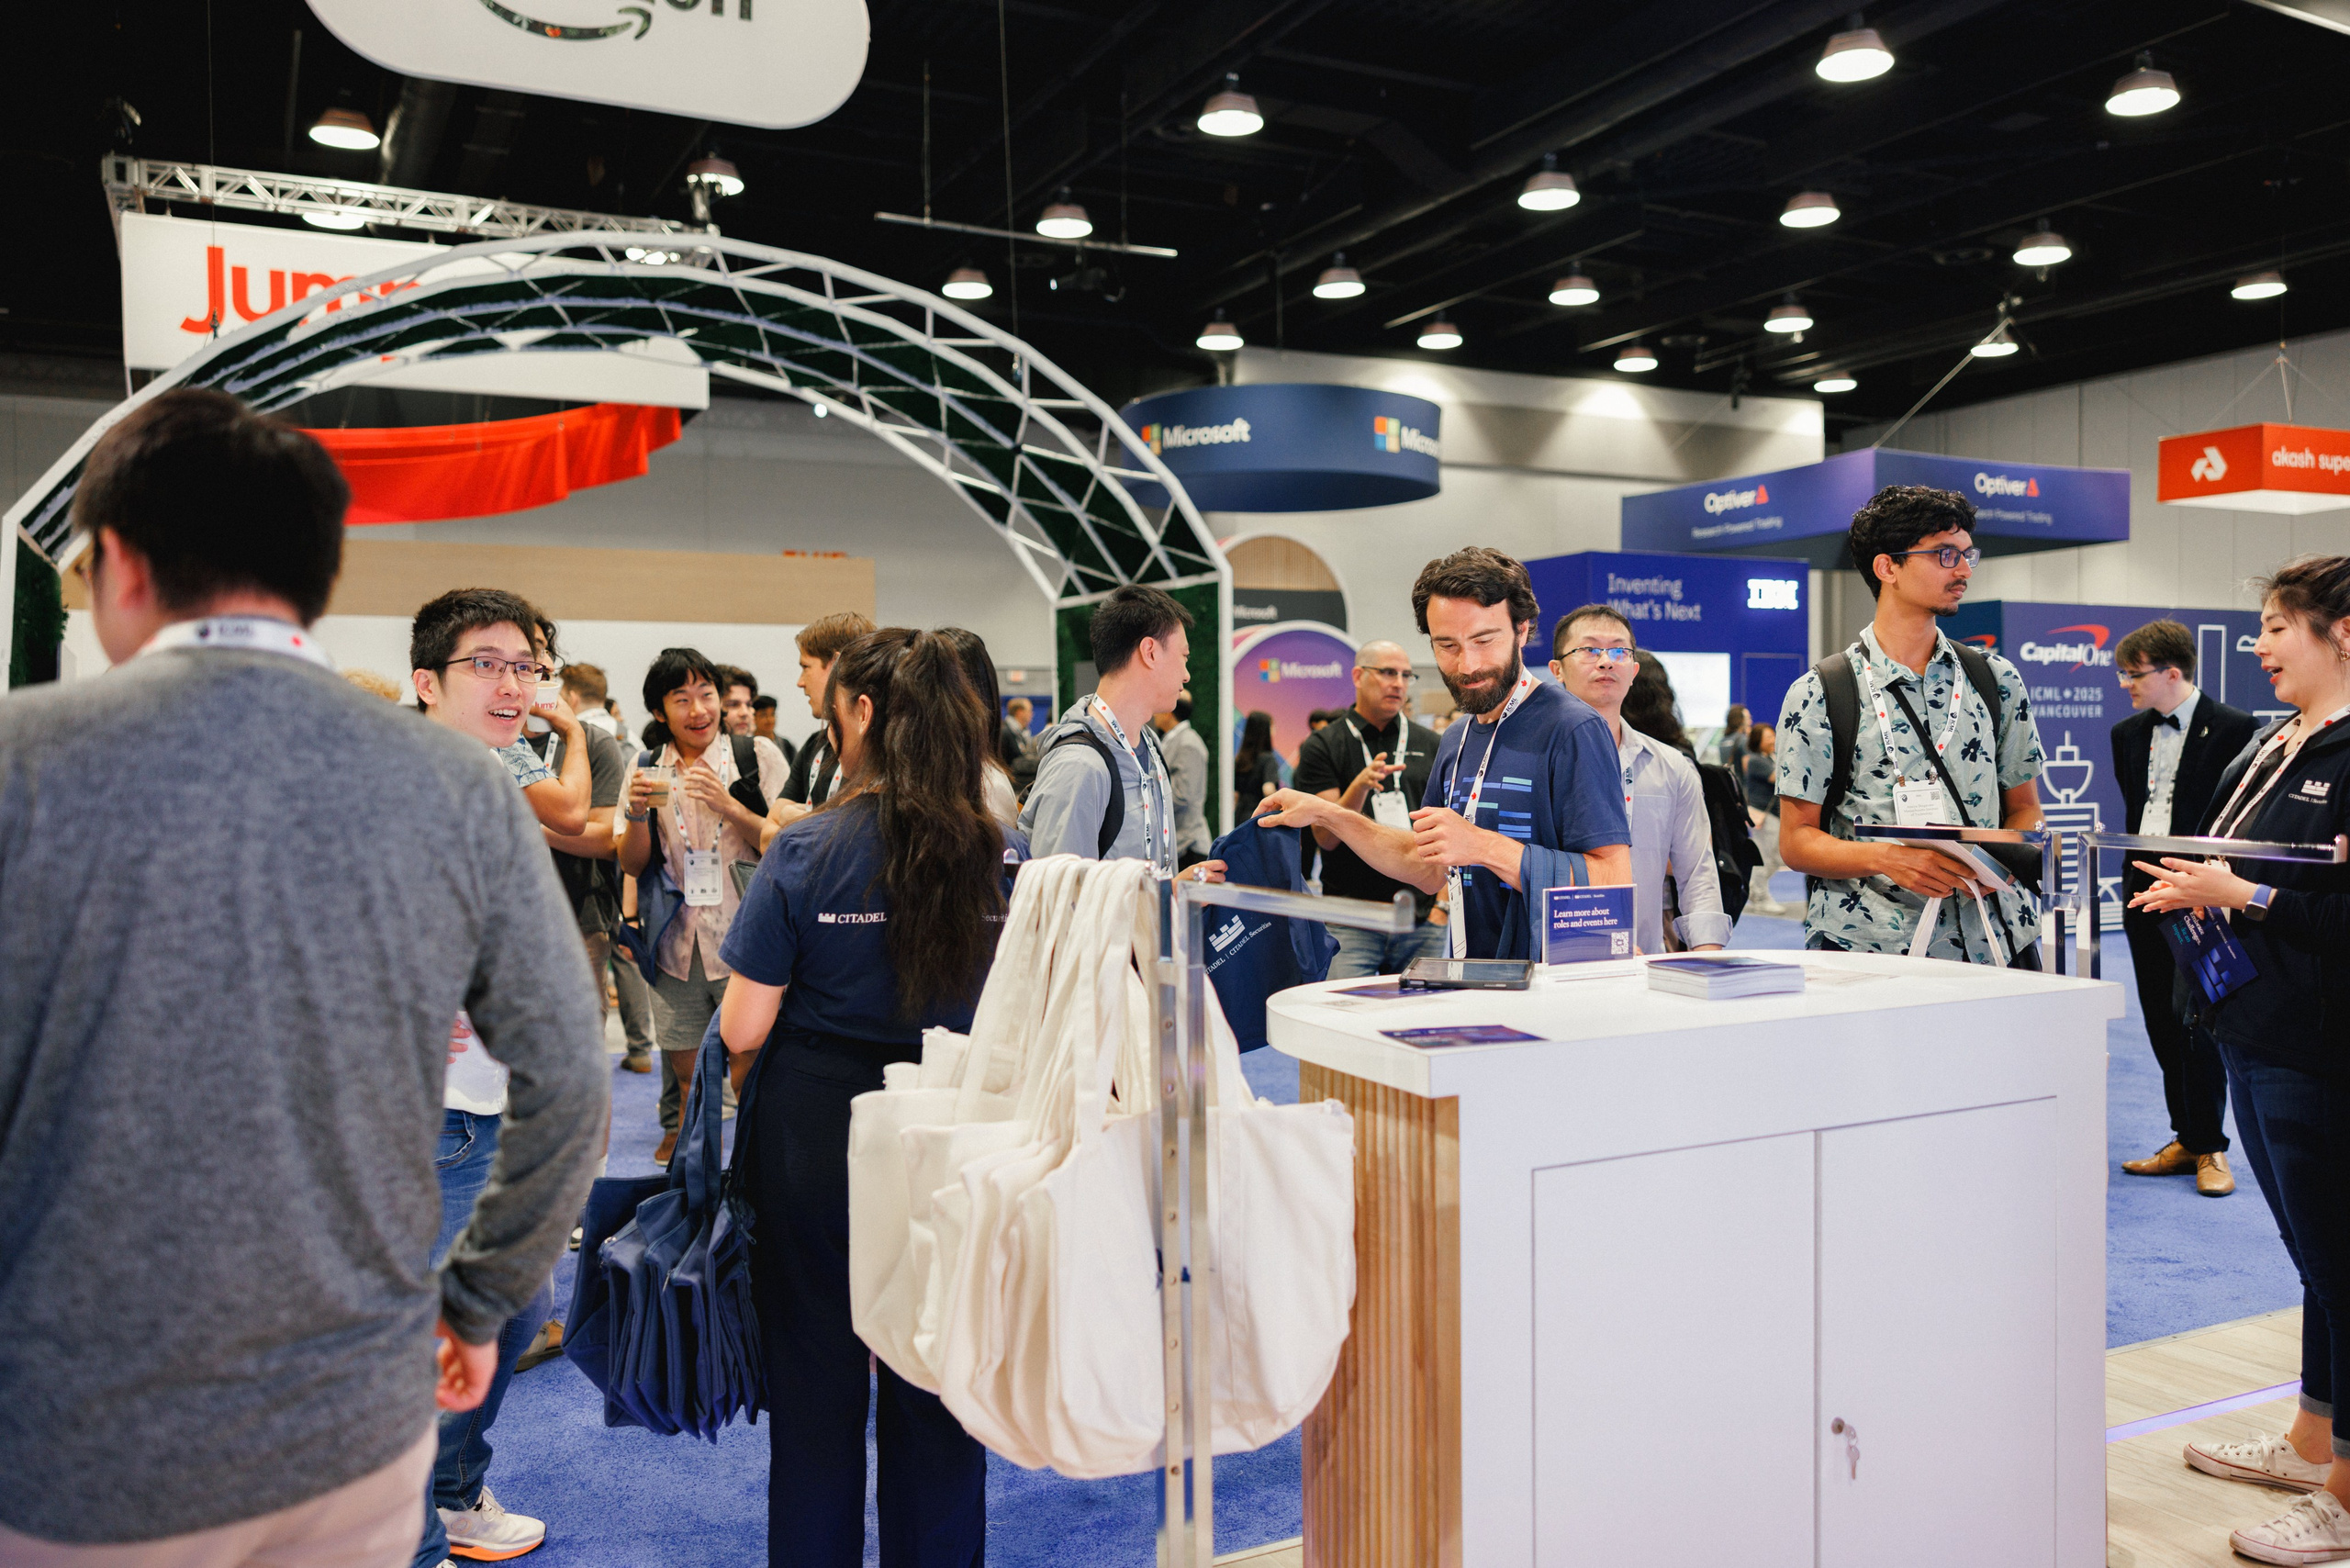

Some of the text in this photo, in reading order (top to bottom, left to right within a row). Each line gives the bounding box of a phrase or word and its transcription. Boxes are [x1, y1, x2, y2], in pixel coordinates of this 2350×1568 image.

[1163, 417, 1251, 449] Microsoft
[2272, 445, 2315, 468] akash
[1975, 472, 2028, 498] Optiver
[1704, 489, 1756, 516] Optiver
[1608, 573, 1684, 600] Inventing
[1748, 578, 1798, 610] IBM
[1664, 601, 1701, 622] Next
[1281, 661, 1342, 678] Microsoft
[2031, 687, 2104, 701] ICML 2025
[1505, 698, 1516, 712] ICML
[2032, 704, 2104, 718] VANCOUVER
[1111, 720, 1121, 734] ICML
[1883, 731, 1891, 745] ICML
[2255, 749, 2266, 762] ICML
[2288, 793, 2310, 801] CITADEL
[837, 912, 887, 924] CITADEL
[1553, 907, 1609, 918] Learn more about
[1553, 916, 1618, 929] roles and events here
[2184, 915, 2201, 946] Challenges.
[2189, 912, 2205, 935] Embrace
[2172, 924, 2183, 945] Impact.
[1204, 922, 1272, 975] ITADEL CITADEL Securities
